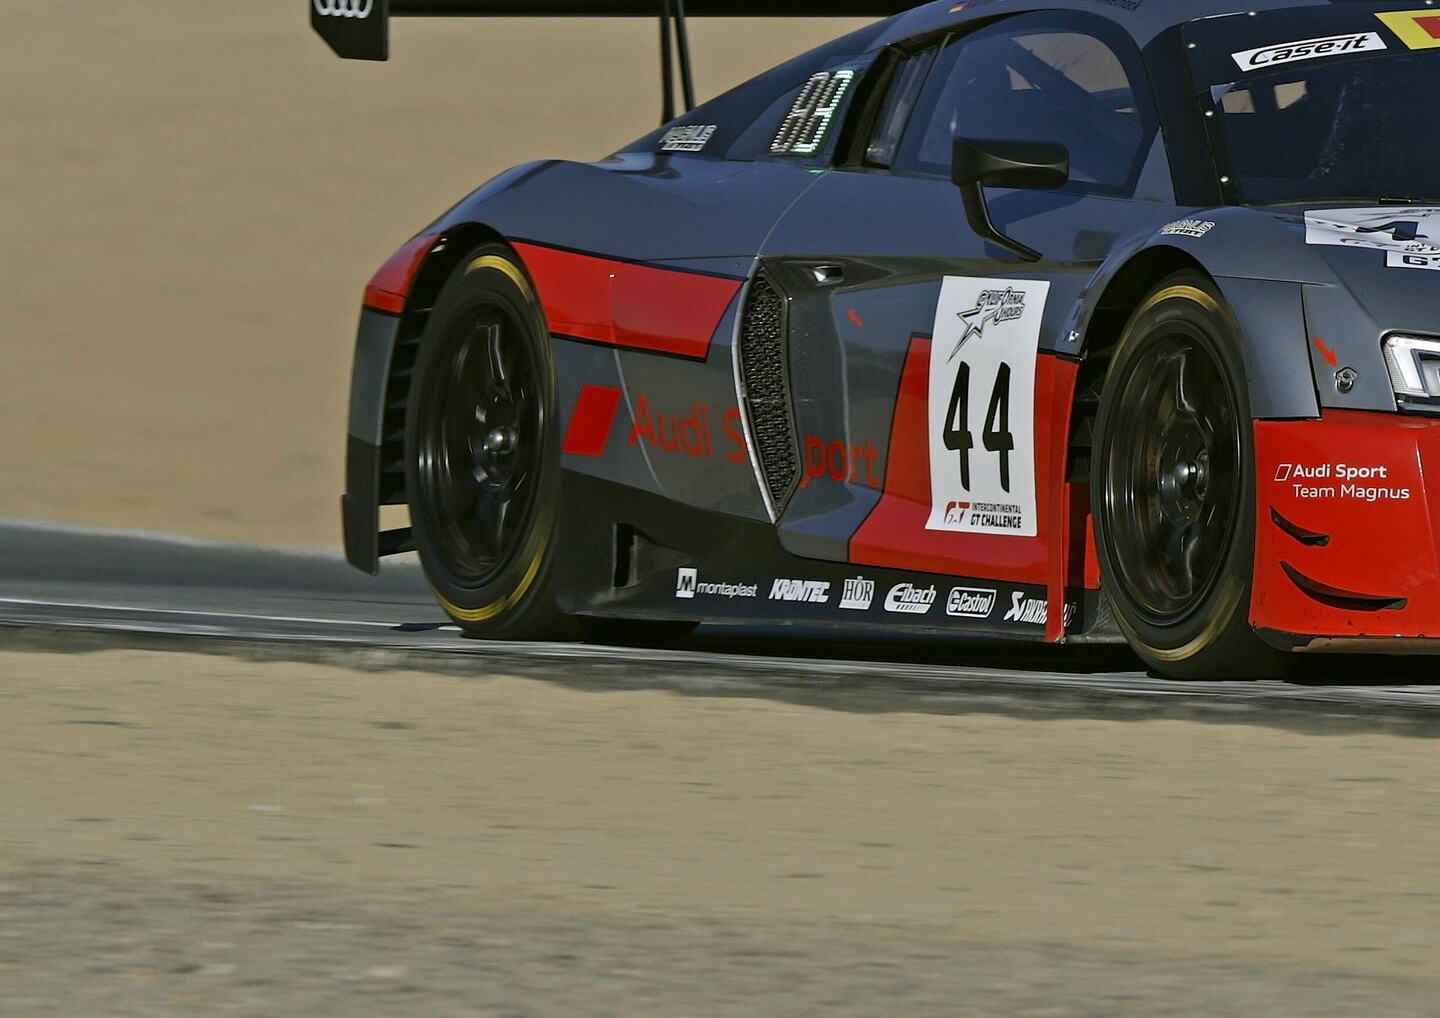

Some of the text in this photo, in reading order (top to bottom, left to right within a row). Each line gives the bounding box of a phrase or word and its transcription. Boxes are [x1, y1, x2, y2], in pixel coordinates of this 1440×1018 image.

[943, 360, 1015, 494] 44
[628, 393, 880, 489] Audi Sport
[1293, 464, 1388, 481] Audi Sport
[1292, 484, 1411, 502] Team Magnus
[971, 502, 1022, 514] INTERCONTINENTAL
[970, 514, 1022, 529] GT CHALLENGE
[696, 582, 758, 599] montaplast
[884, 583, 937, 613] Eibach
[957, 592, 993, 613] Castrol
